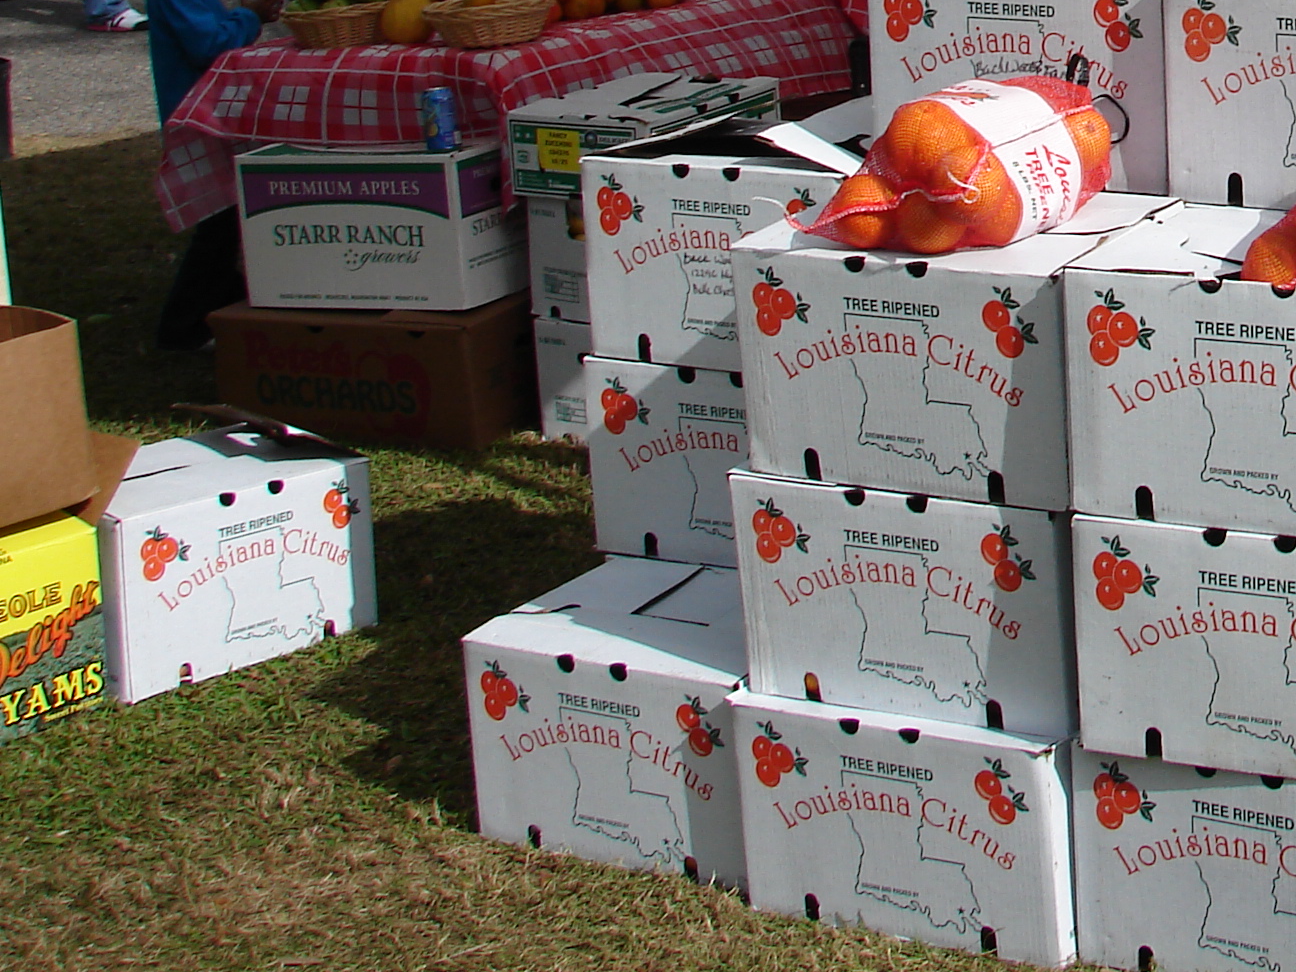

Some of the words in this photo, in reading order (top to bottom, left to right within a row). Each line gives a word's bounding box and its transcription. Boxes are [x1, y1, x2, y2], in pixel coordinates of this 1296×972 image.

[968, 1, 999, 15] TREE
[1002, 3, 1055, 18] RIPENED
[901, 26, 1031, 83] Louisiana
[269, 180, 353, 196] PREMIUM
[359, 180, 420, 196] APPLES
[671, 199, 700, 212] TREE
[702, 202, 751, 216] RIPENED
[274, 224, 342, 247] STARR
[347, 225, 425, 247] RANCH
[613, 224, 731, 275] Louisiana
[345, 249, 421, 271] growers
[843, 297, 878, 313] TREE
[882, 299, 940, 318] RIPENED
[1195, 320, 1235, 337] TREE
[773, 325, 918, 380] Louisiana
[927, 334, 1024, 407] Citrus
[1107, 351, 1277, 414] Louisiana
[678, 402, 707, 416] TREE
[711, 406, 746, 420] RIPEN
[619, 425, 740, 472] Louisiana
[219, 526, 247, 539] TREE
[249, 510, 294, 529] RIPENED
[843, 529, 878, 545] TREE
[882, 531, 940, 552] RIPENED
[157, 538, 276, 612] Louisiana
[283, 528, 350, 567] Citrus
[1199, 570, 1238, 588] TREE
[0, 581, 62, 622] EOLE
[774, 554, 917, 607] Louisiana
[927, 566, 1022, 640] Citrus
[1114, 601, 1279, 656] Louisiana
[0, 662, 104, 726] YAMS
[558, 692, 588, 708] TREE
[591, 698, 641, 717] RIPENED
[499, 716, 622, 761] Louisiana
[629, 730, 714, 801] Citrus
[840, 755, 873, 771] TREE
[877, 758, 934, 782] RIPENED
[773, 783, 912, 829] Louisiana
[921, 798, 1017, 870] Citrus
[1192, 800, 1229, 818] TREE
[1232, 805, 1295, 830] RIPENED
[1113, 826, 1268, 875] Louisiana
